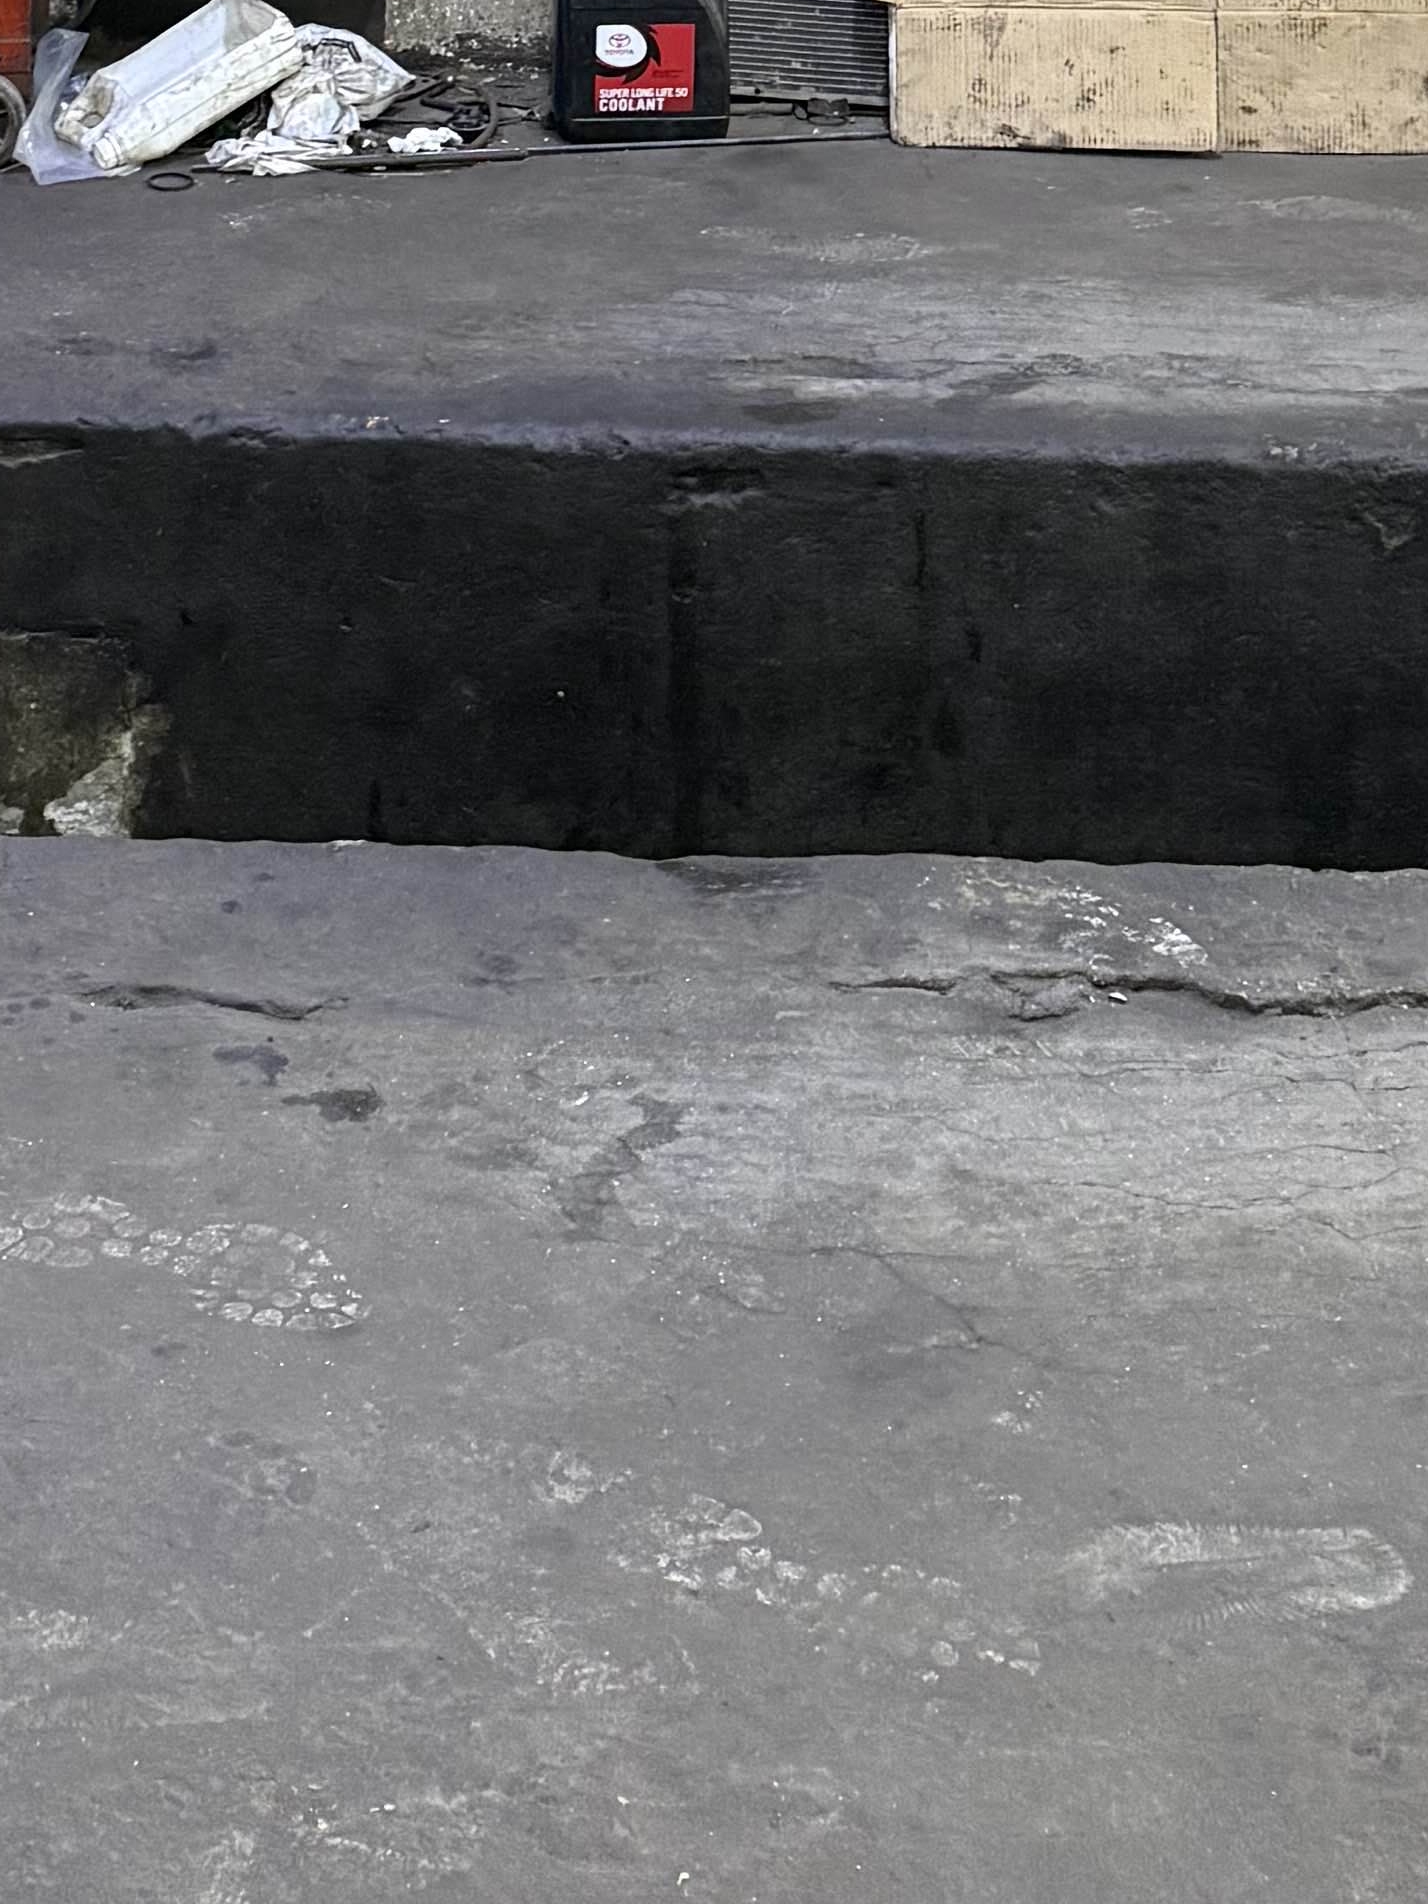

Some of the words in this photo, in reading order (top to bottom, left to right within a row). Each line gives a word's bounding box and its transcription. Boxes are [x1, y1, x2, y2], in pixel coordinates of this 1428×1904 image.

[599, 88, 630, 98] SUPER
[674, 88, 689, 97] 50
[598, 97, 665, 112] COOLANT
